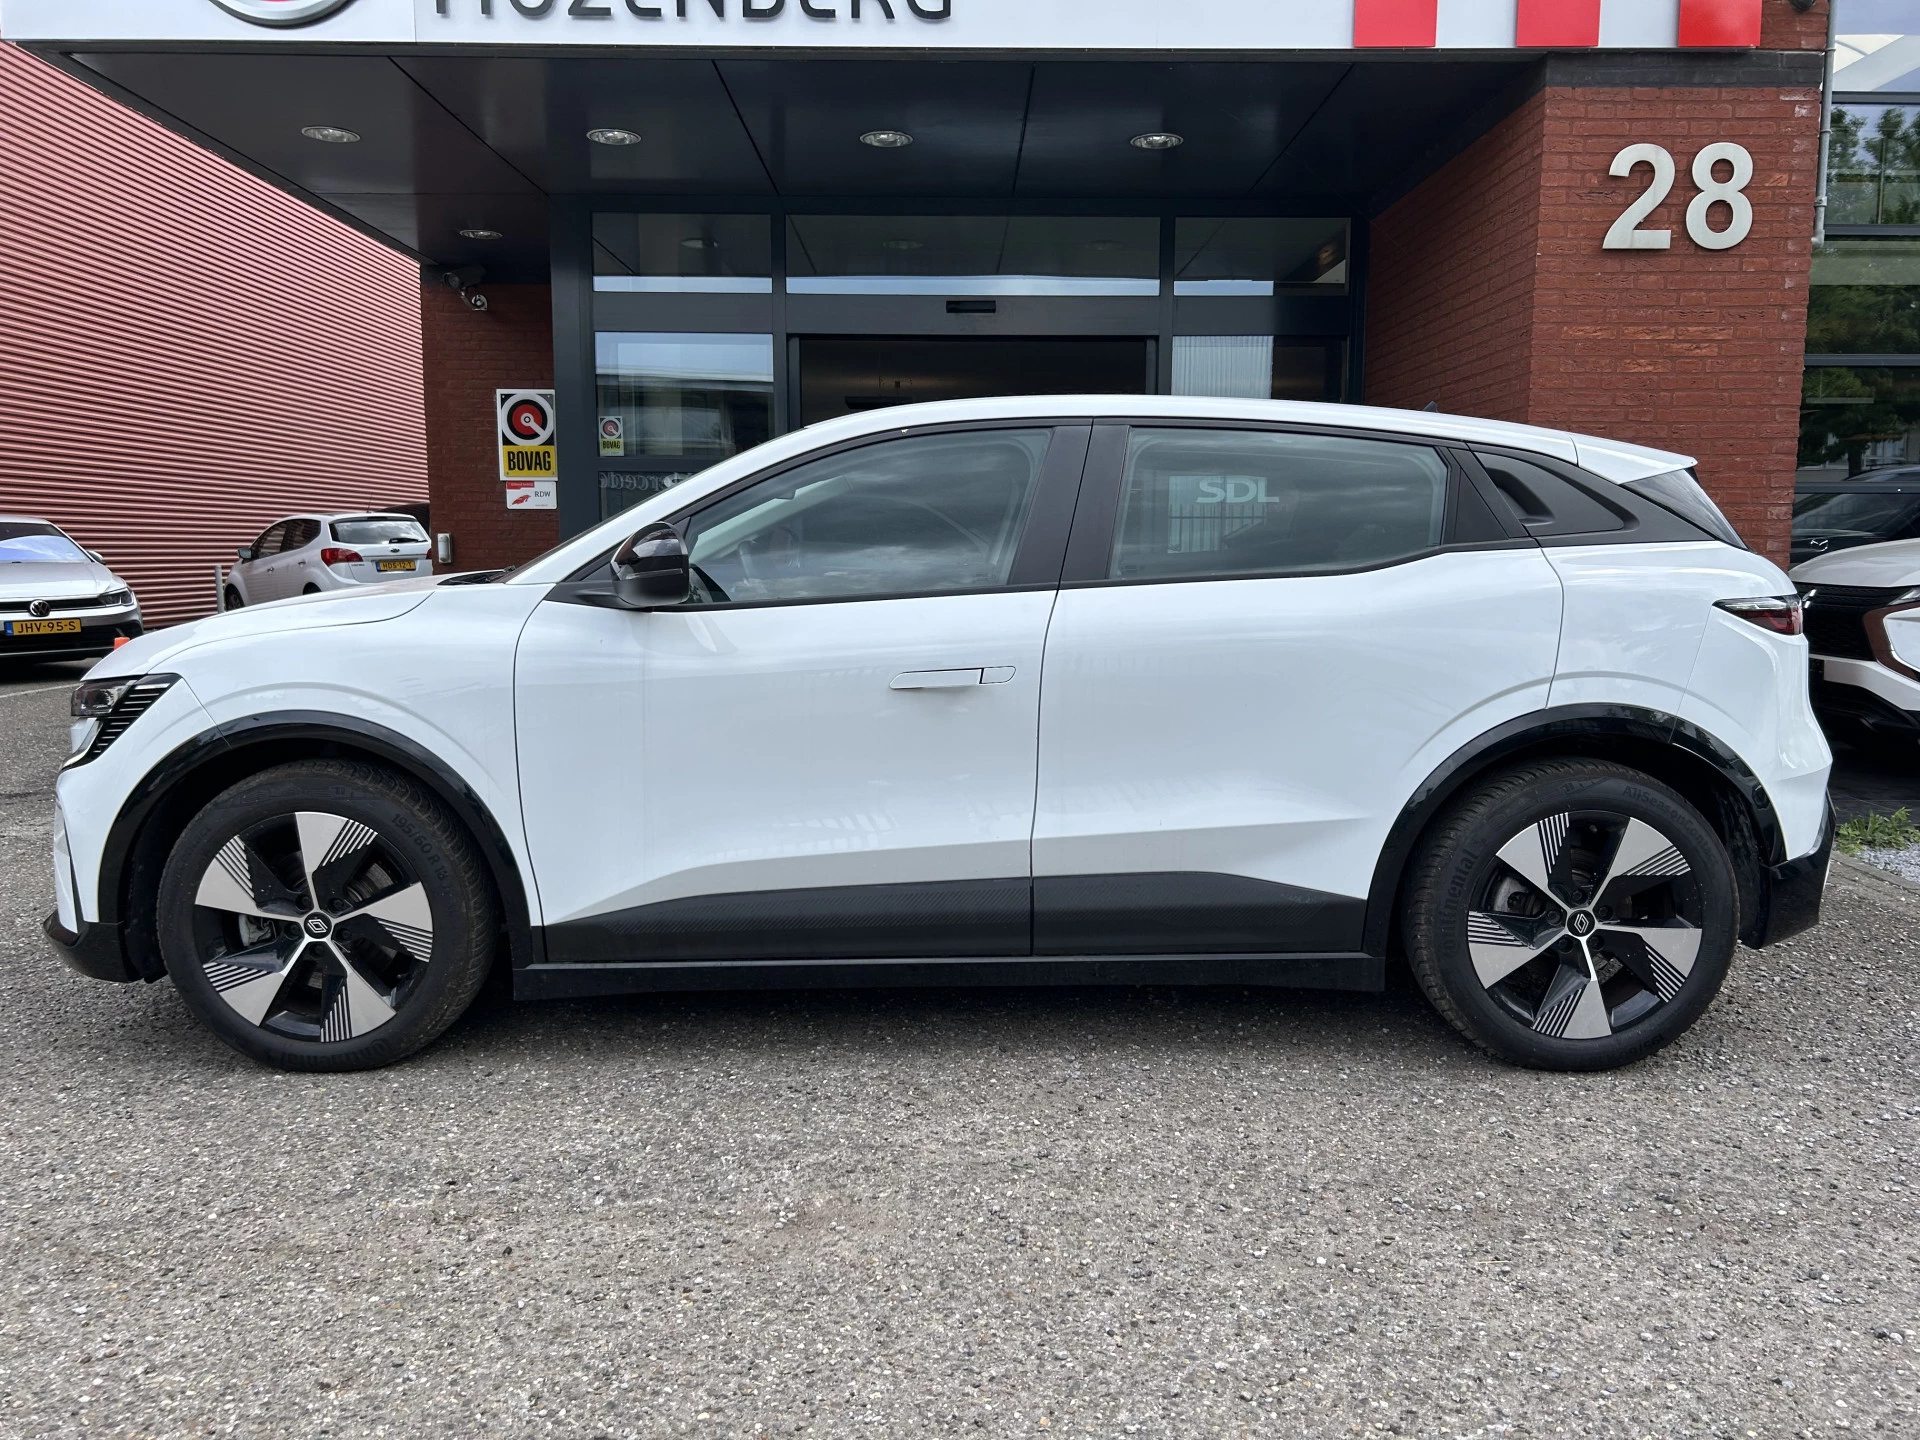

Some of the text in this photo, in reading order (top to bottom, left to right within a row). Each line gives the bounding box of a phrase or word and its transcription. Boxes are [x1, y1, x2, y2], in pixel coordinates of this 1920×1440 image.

[1602, 142, 1753, 250] 28
[602, 440, 621, 449] BOVAG
[507, 450, 551, 471] BOVAG
[534, 490, 551, 498] RDW
[1196, 475, 1280, 503] SDL
[18, 621, 76, 633] JHV-95-S
[391, 813, 433, 855] 195/60
[428, 854, 441, 865] R
